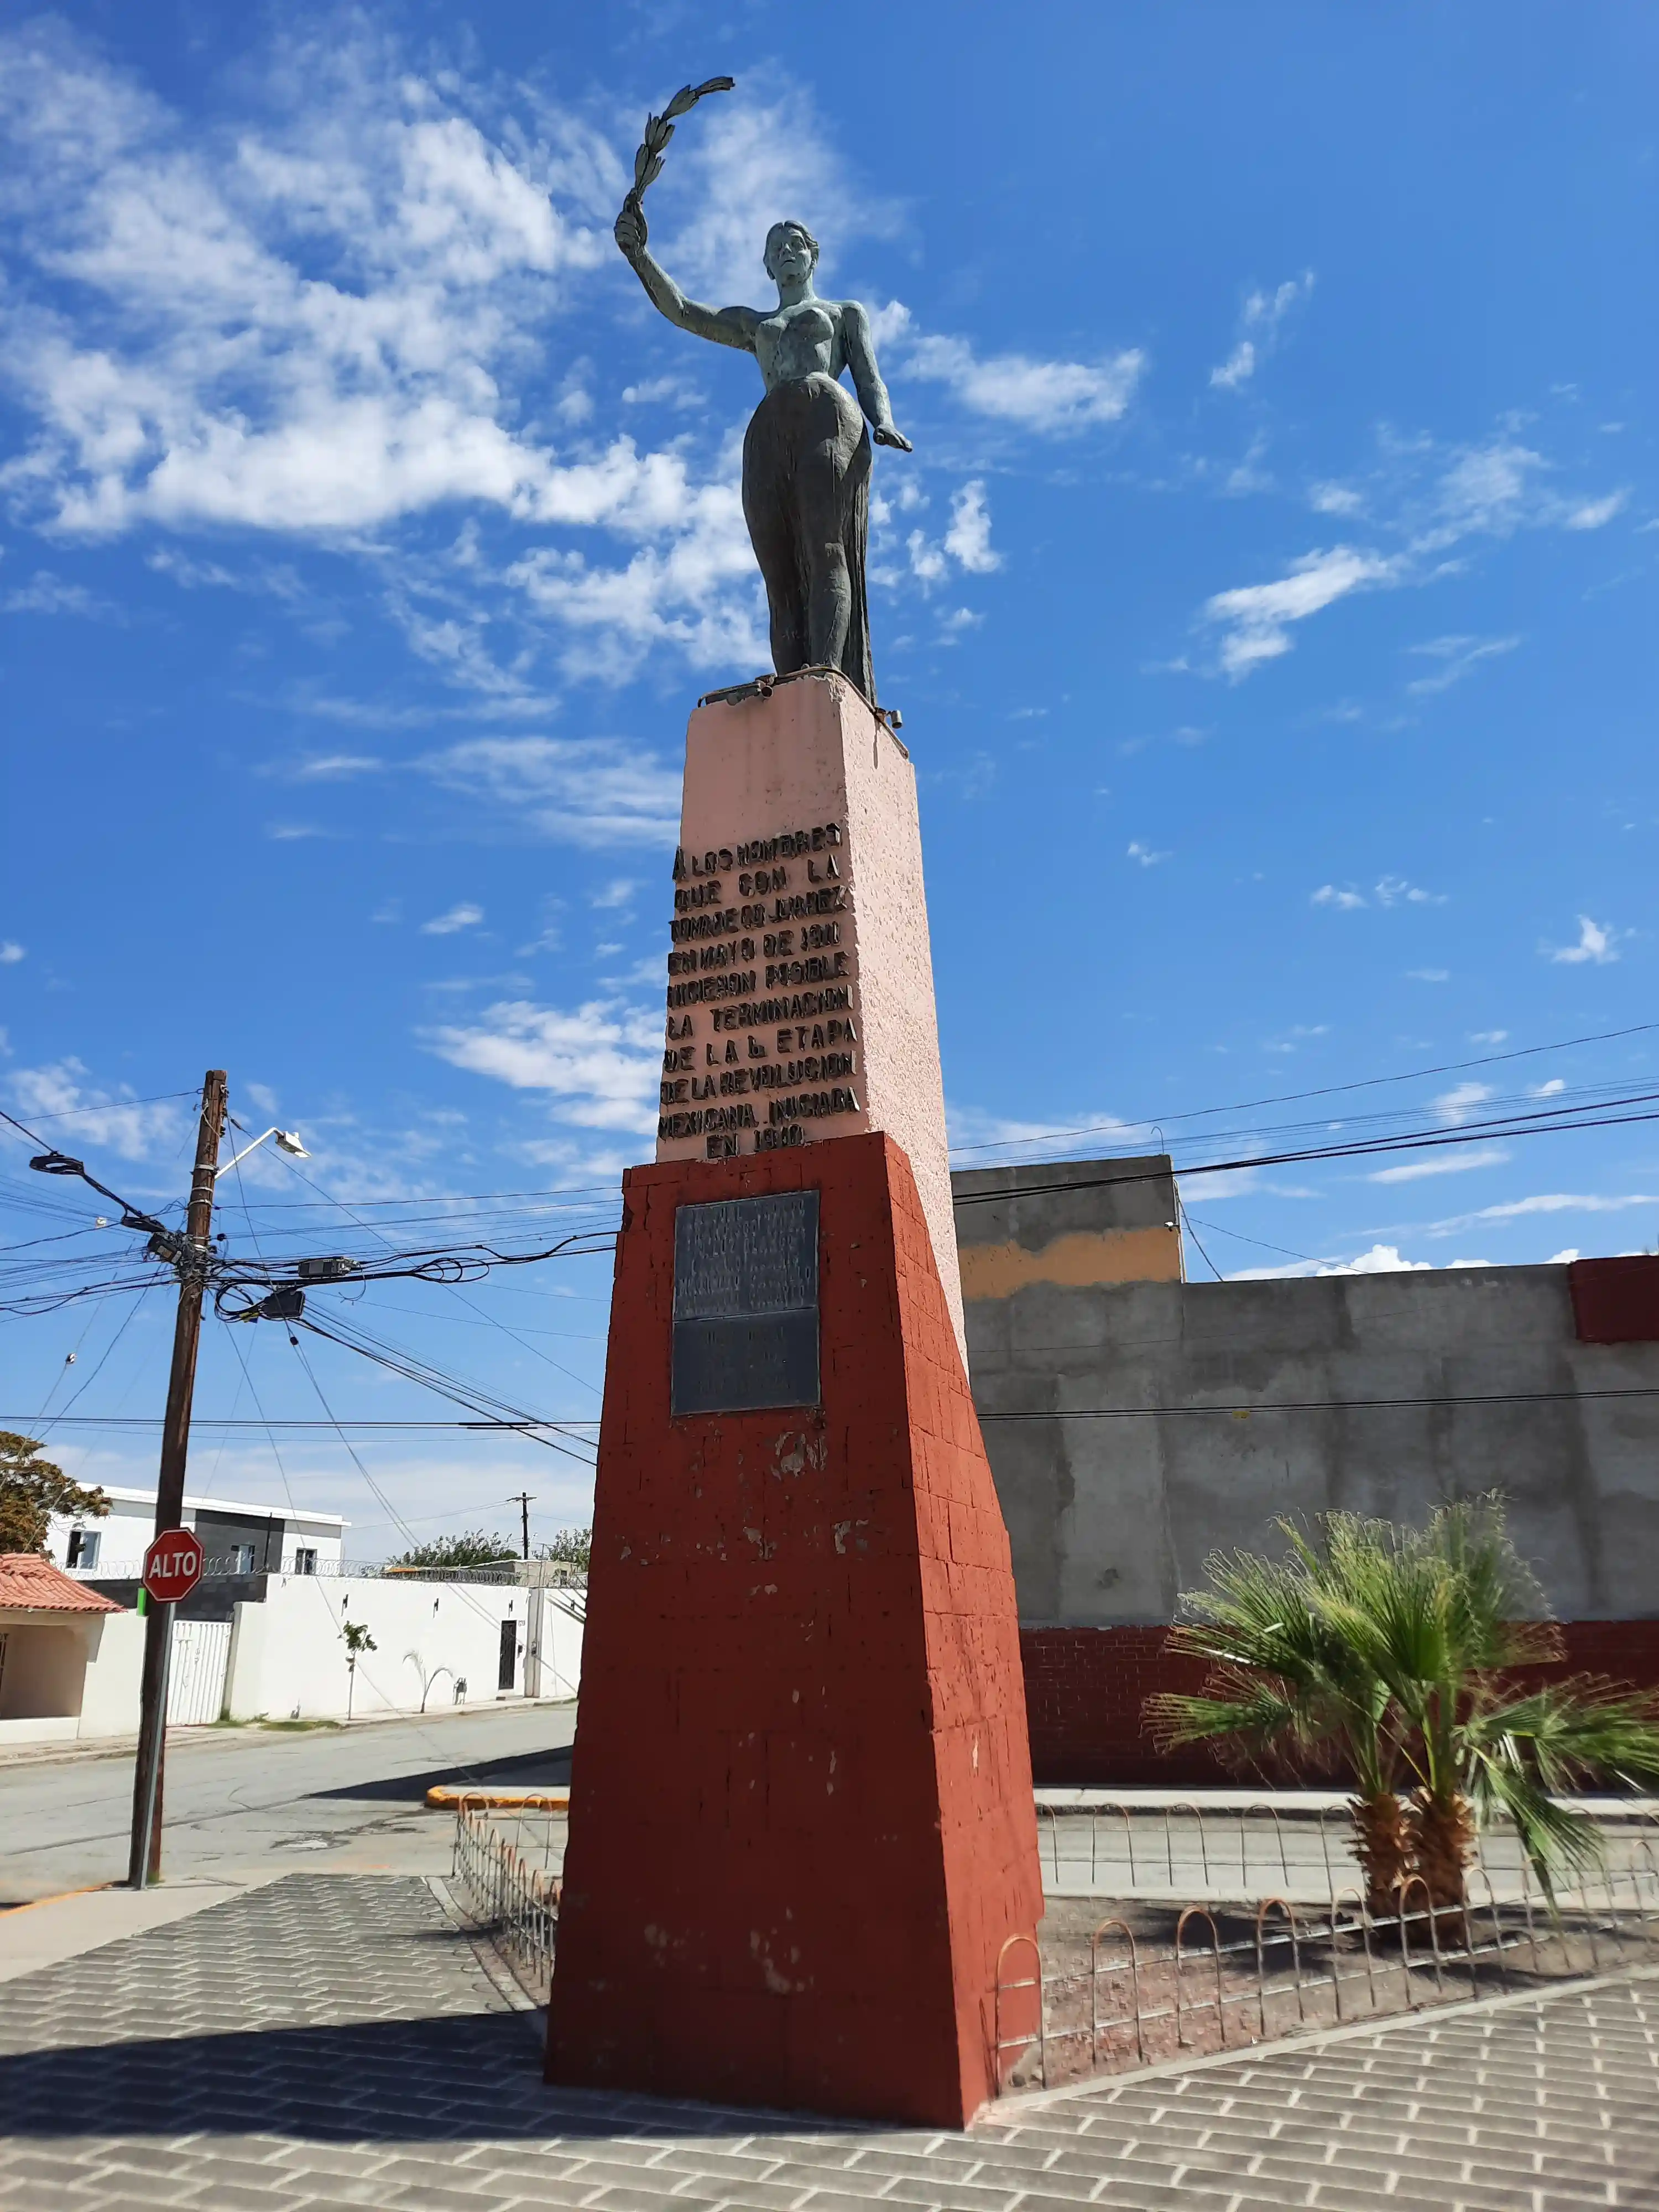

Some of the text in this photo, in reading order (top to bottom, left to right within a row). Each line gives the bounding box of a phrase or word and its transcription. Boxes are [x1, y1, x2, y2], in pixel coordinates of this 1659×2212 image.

[692, 848, 733, 877] LOS
[737, 822, 842, 867] HOMBRES
[674, 854, 841, 913] QUE CON LA
[667, 950, 697, 975] EN
[700, 937, 756, 971] MAYO
[763, 930, 794, 957] DE
[667, 951, 851, 1009] HICIERON POSIBLE
[667, 984, 854, 1040] LA TERMINACION
[663, 1046, 696, 1073] DE
[706, 1039, 739, 1066] LA
[777, 1018, 858, 1053] ETAPA
[660, 1050, 857, 1105] DE LA REVOLUCION
[769, 1087, 860, 1126] INICIADA
[707, 1133, 739, 1159] EN
[149, 1551, 196, 1578] ALTO
